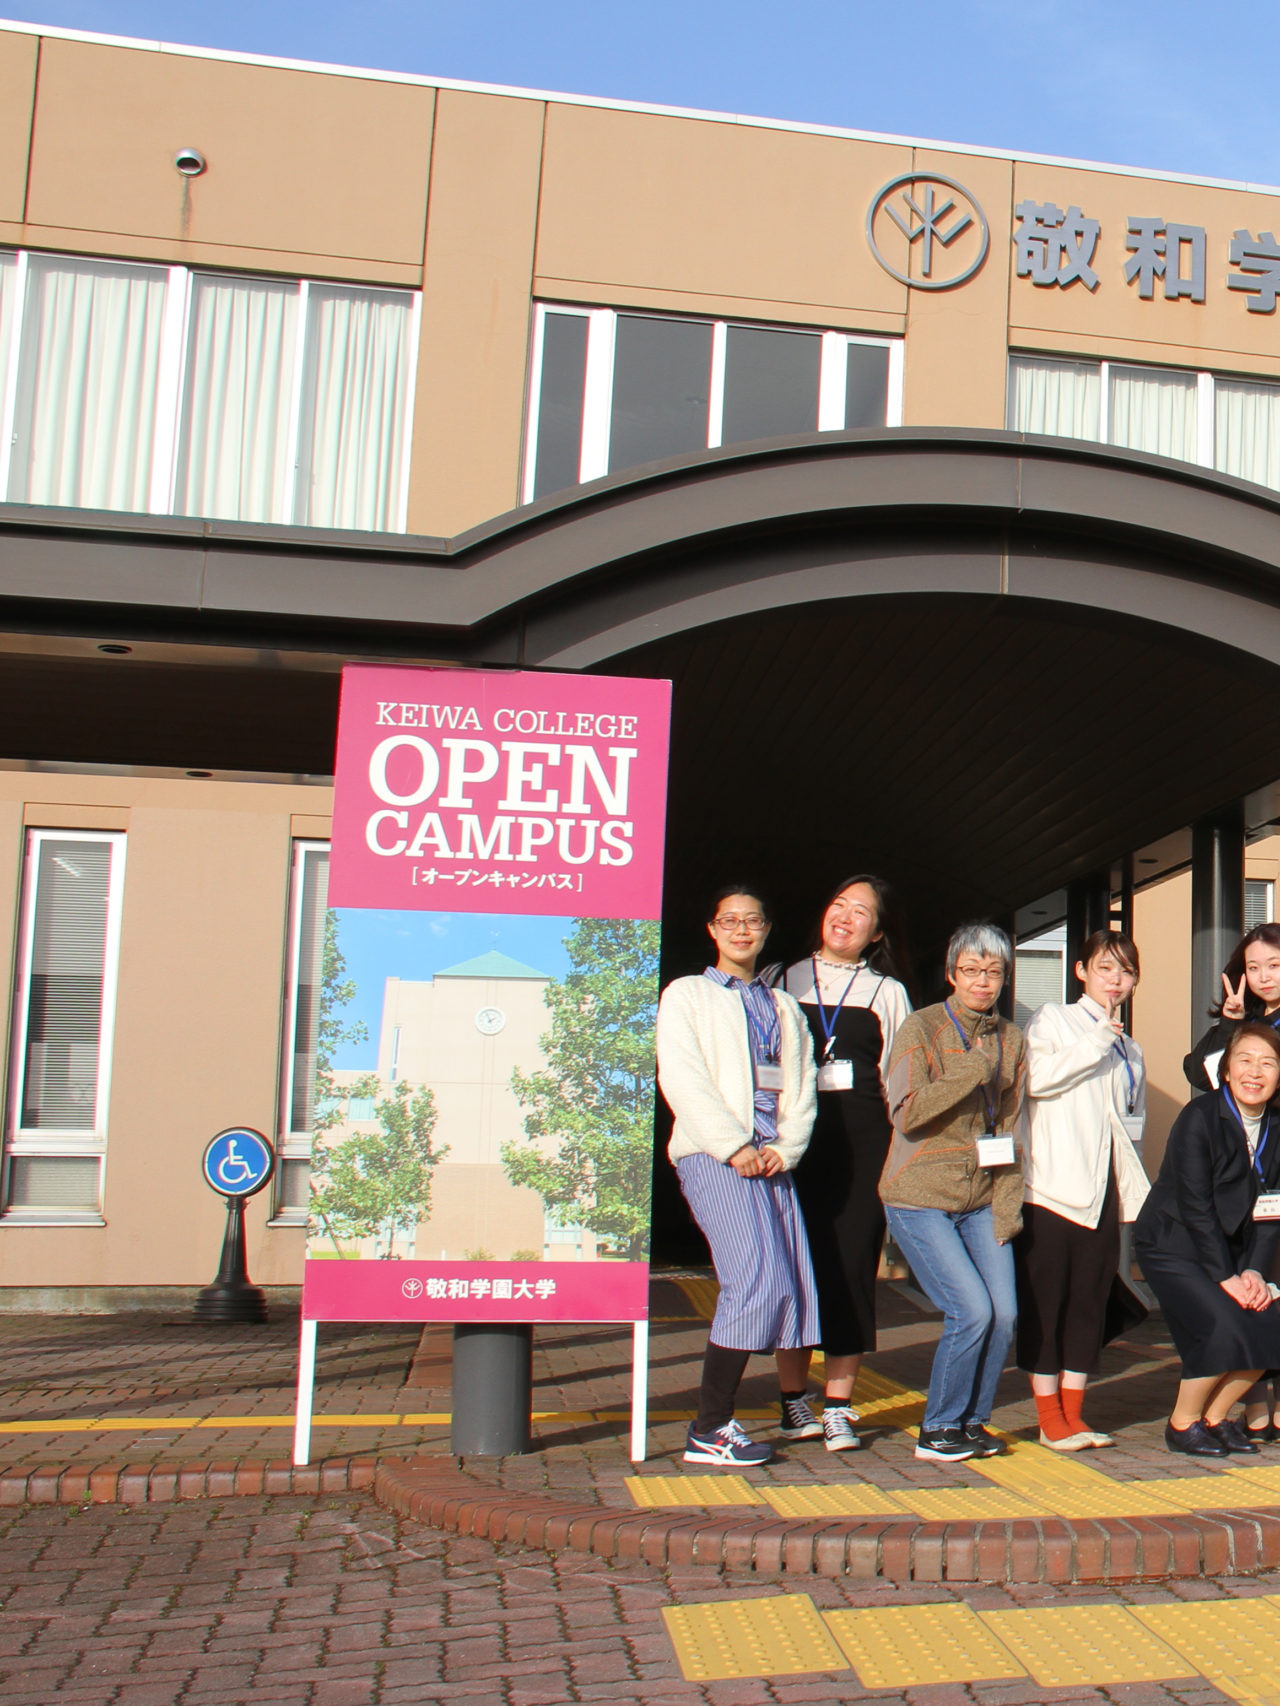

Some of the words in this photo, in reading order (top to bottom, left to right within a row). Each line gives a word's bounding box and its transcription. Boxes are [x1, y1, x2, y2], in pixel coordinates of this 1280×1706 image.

[375, 701, 484, 731] KEIWA
[493, 708, 639, 740] COLLEGE
[368, 734, 638, 816] OPEN
[365, 809, 634, 867] CAMPUS
[426, 1278, 557, 1301] 敬和学園大学
